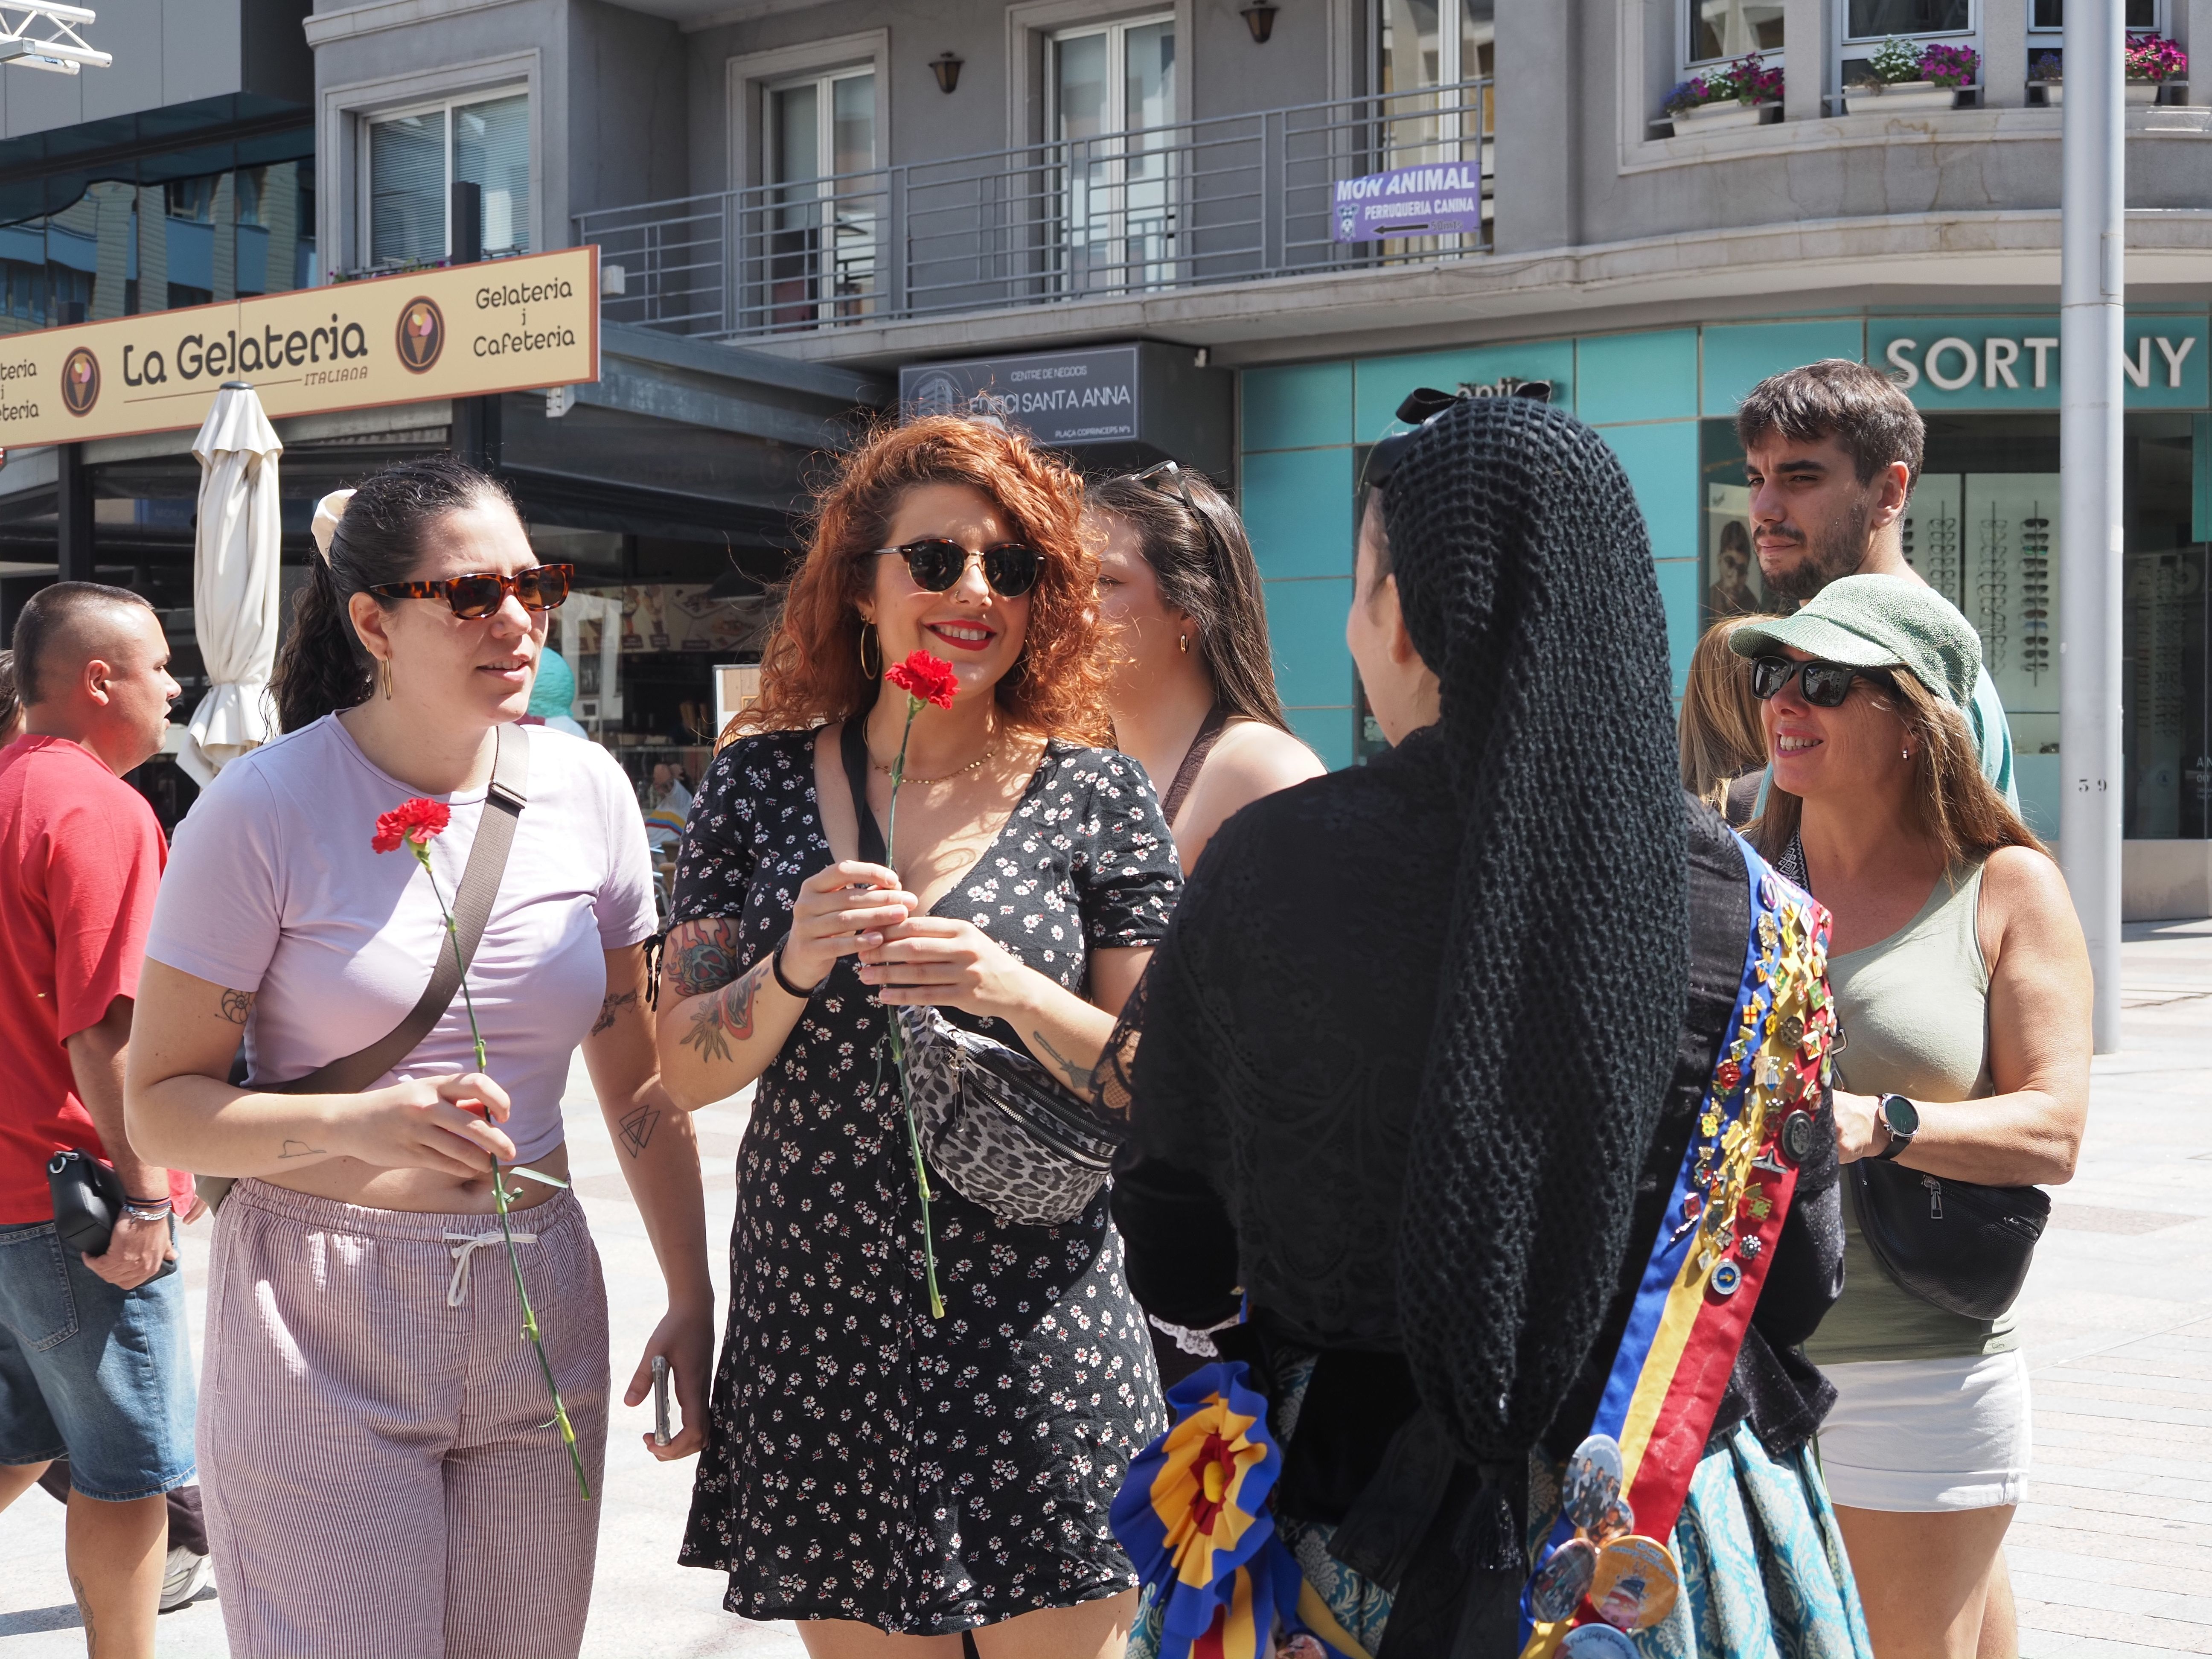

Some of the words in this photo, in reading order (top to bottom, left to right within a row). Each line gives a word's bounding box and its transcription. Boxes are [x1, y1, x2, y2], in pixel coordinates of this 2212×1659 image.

[1385, 167, 1476, 195] ANIMAL
[1365, 200, 1431, 221] PERRUQUERIA
[1434, 197, 1475, 214] CANINA
[476, 277, 572, 309] Gelateria
[123, 345, 167, 387] La
[177, 313, 368, 380] Gelateria
[473, 325, 575, 357] Cafeteria
[0, 359, 37, 380] teria
[304, 365, 368, 386] ITALIANA
[1010, 369, 1042, 381] CENTRE
[1042, 368, 1053, 379] DE
[1054, 365, 1087, 378] NEGOCIS
[1886, 337, 2196, 390] SORTNY
[0, 399, 39, 422] teria
[1022, 390, 1079, 413] SANTA
[1081, 385, 1131, 408] ANNA
